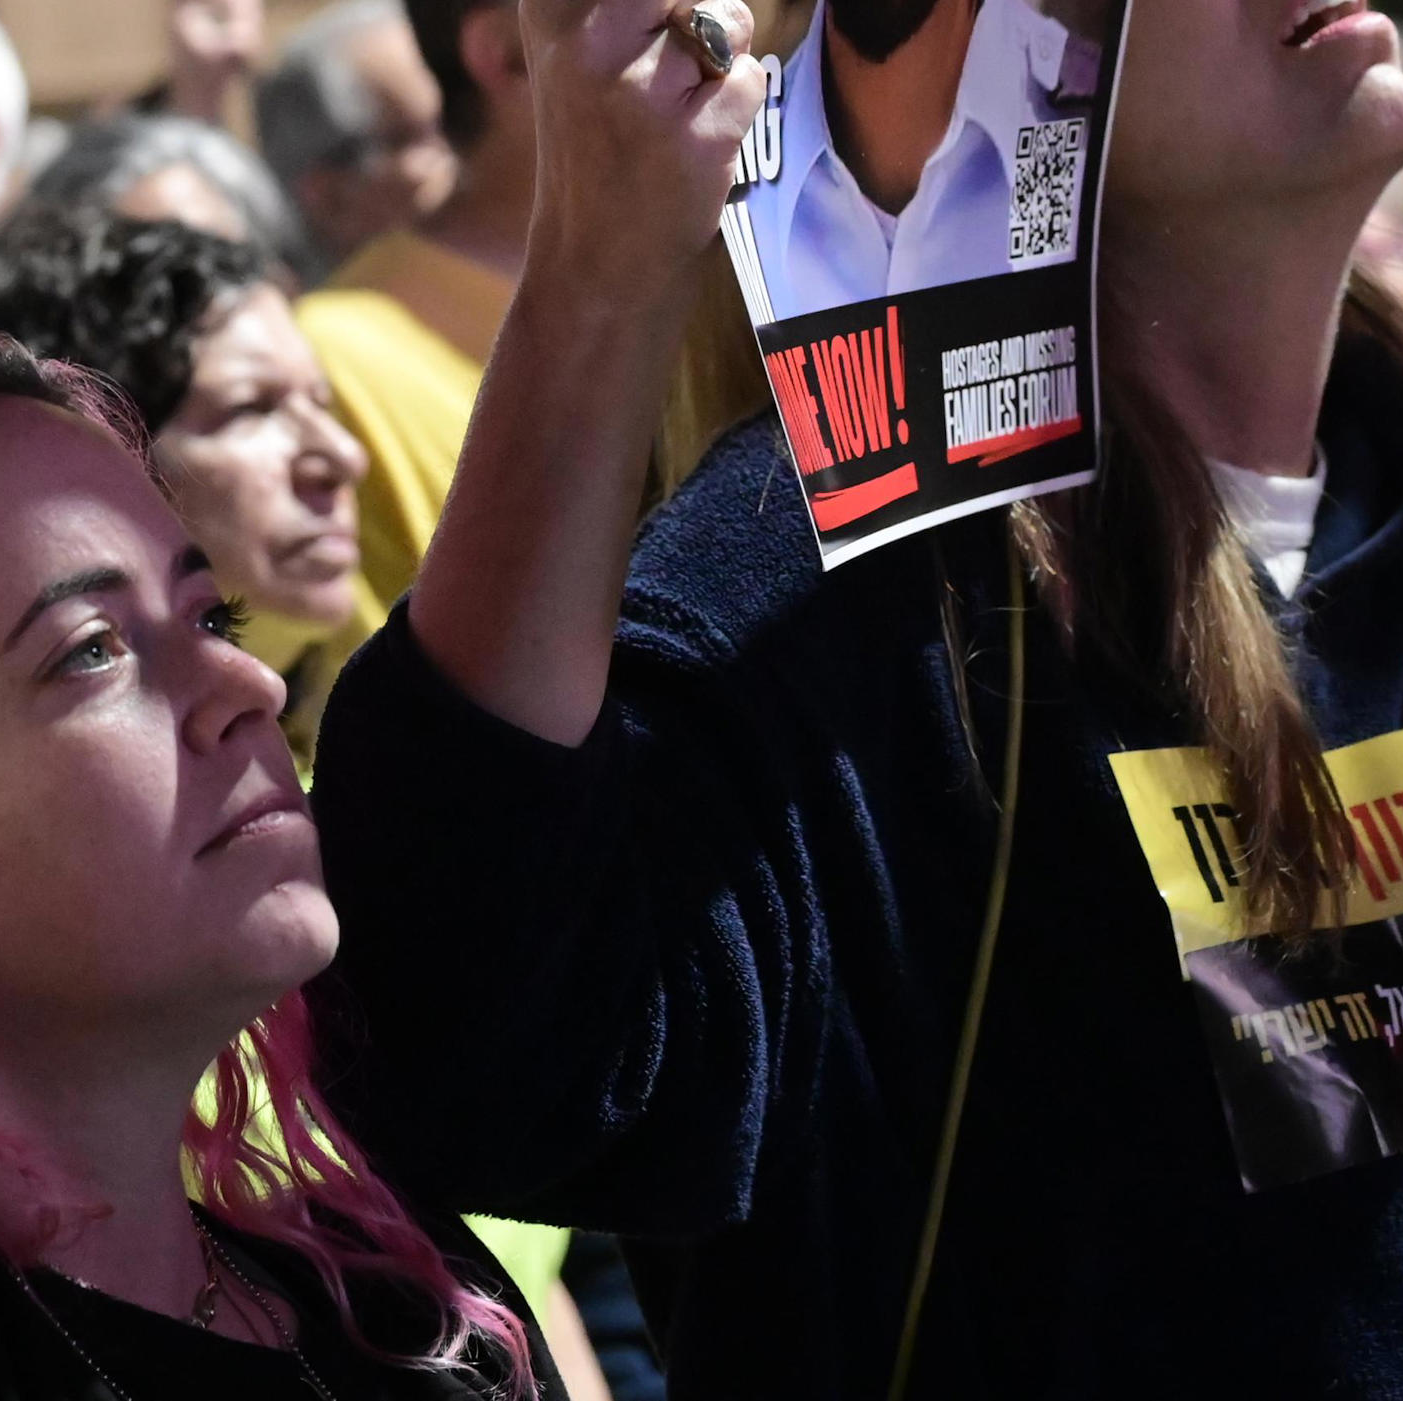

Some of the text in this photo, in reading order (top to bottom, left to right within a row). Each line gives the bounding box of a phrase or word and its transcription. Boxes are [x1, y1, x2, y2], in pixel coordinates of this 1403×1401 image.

[810, 305, 910, 464] NOW!
[941, 340, 1001, 391] HOSTAGES
[1000, 335, 1025, 378] AND
[943, 364, 1078, 449] FAMILIES FORUM
[1334, 991, 1379, 1042] זה
